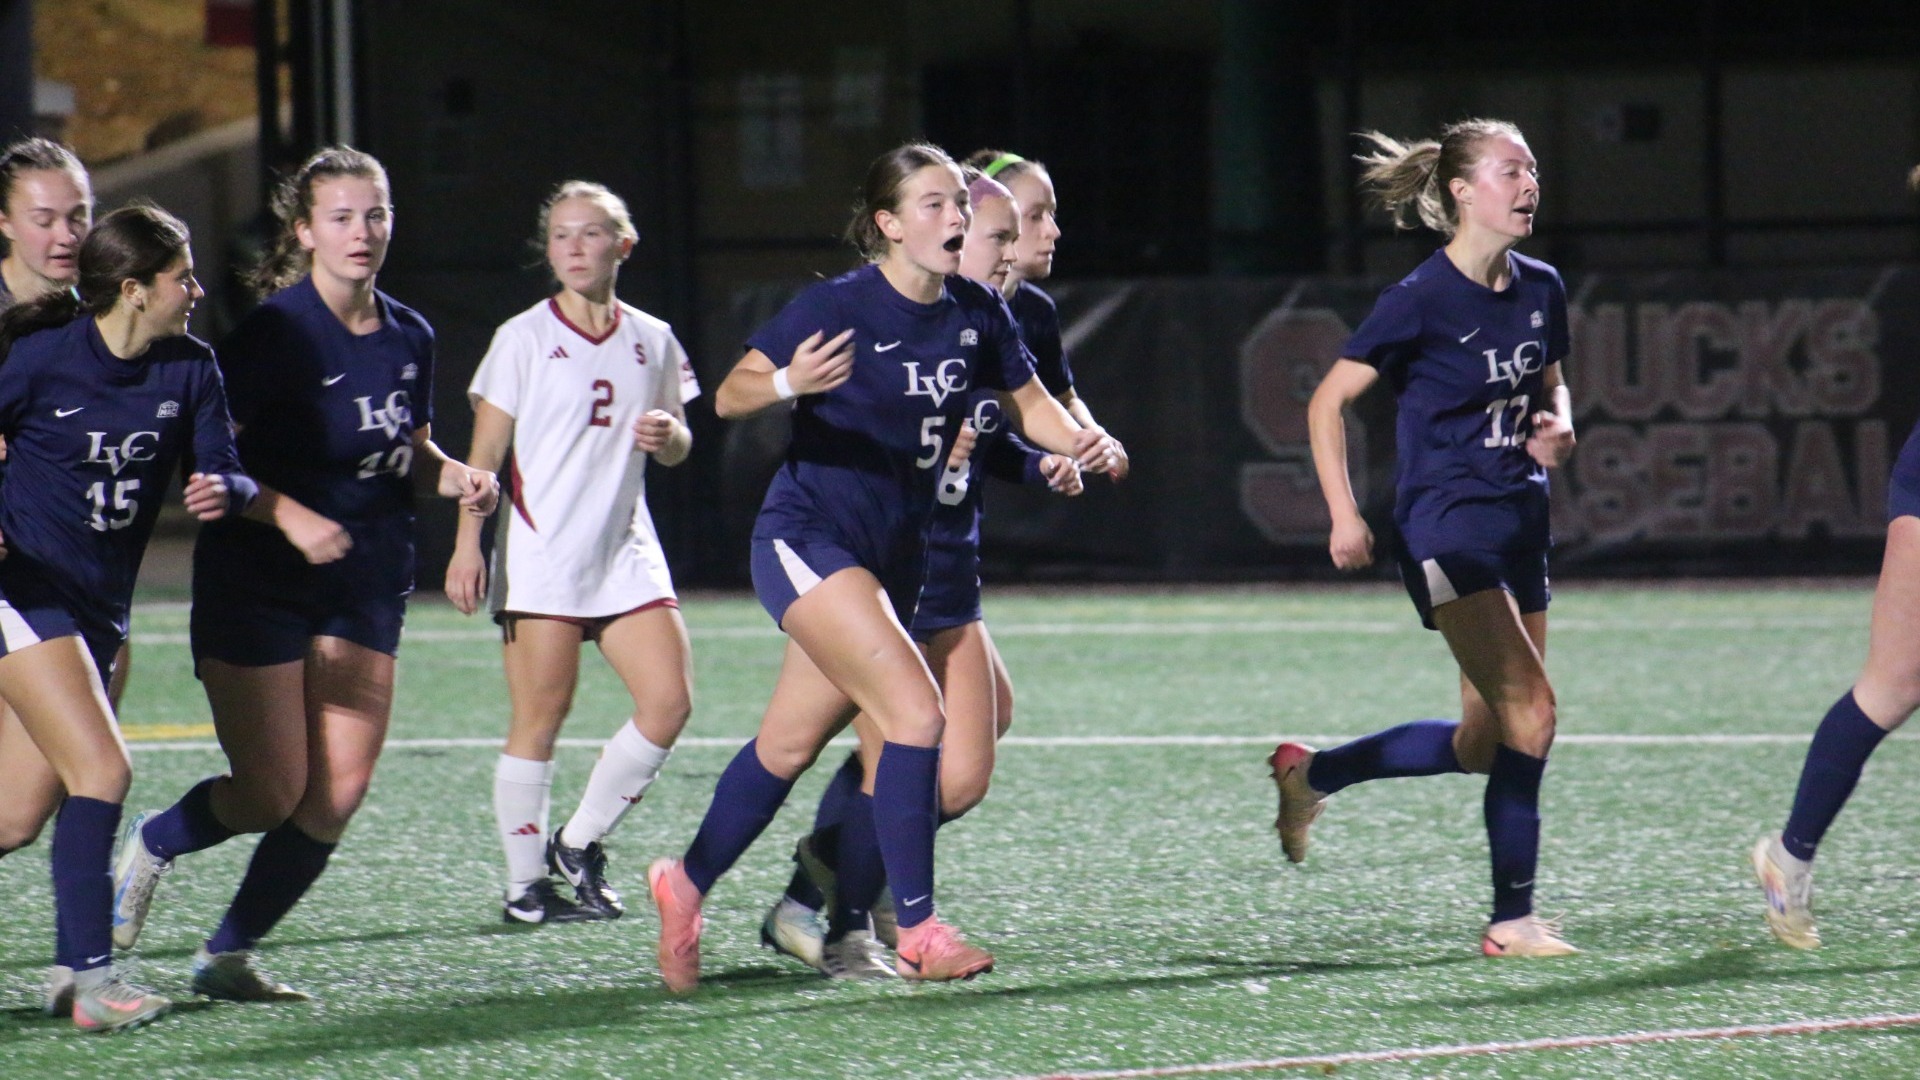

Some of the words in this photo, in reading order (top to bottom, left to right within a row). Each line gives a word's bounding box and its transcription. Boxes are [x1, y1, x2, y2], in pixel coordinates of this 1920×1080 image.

[634, 343, 647, 366] S
[1482, 341, 1542, 390] LVC
[590, 379, 614, 428] 2
[902, 358, 968, 409] LVC
[916, 416, 946, 470] 5
[1484, 394, 1530, 448] 12
[82, 431, 160, 476] LVC
[84, 478, 140, 531] 15
